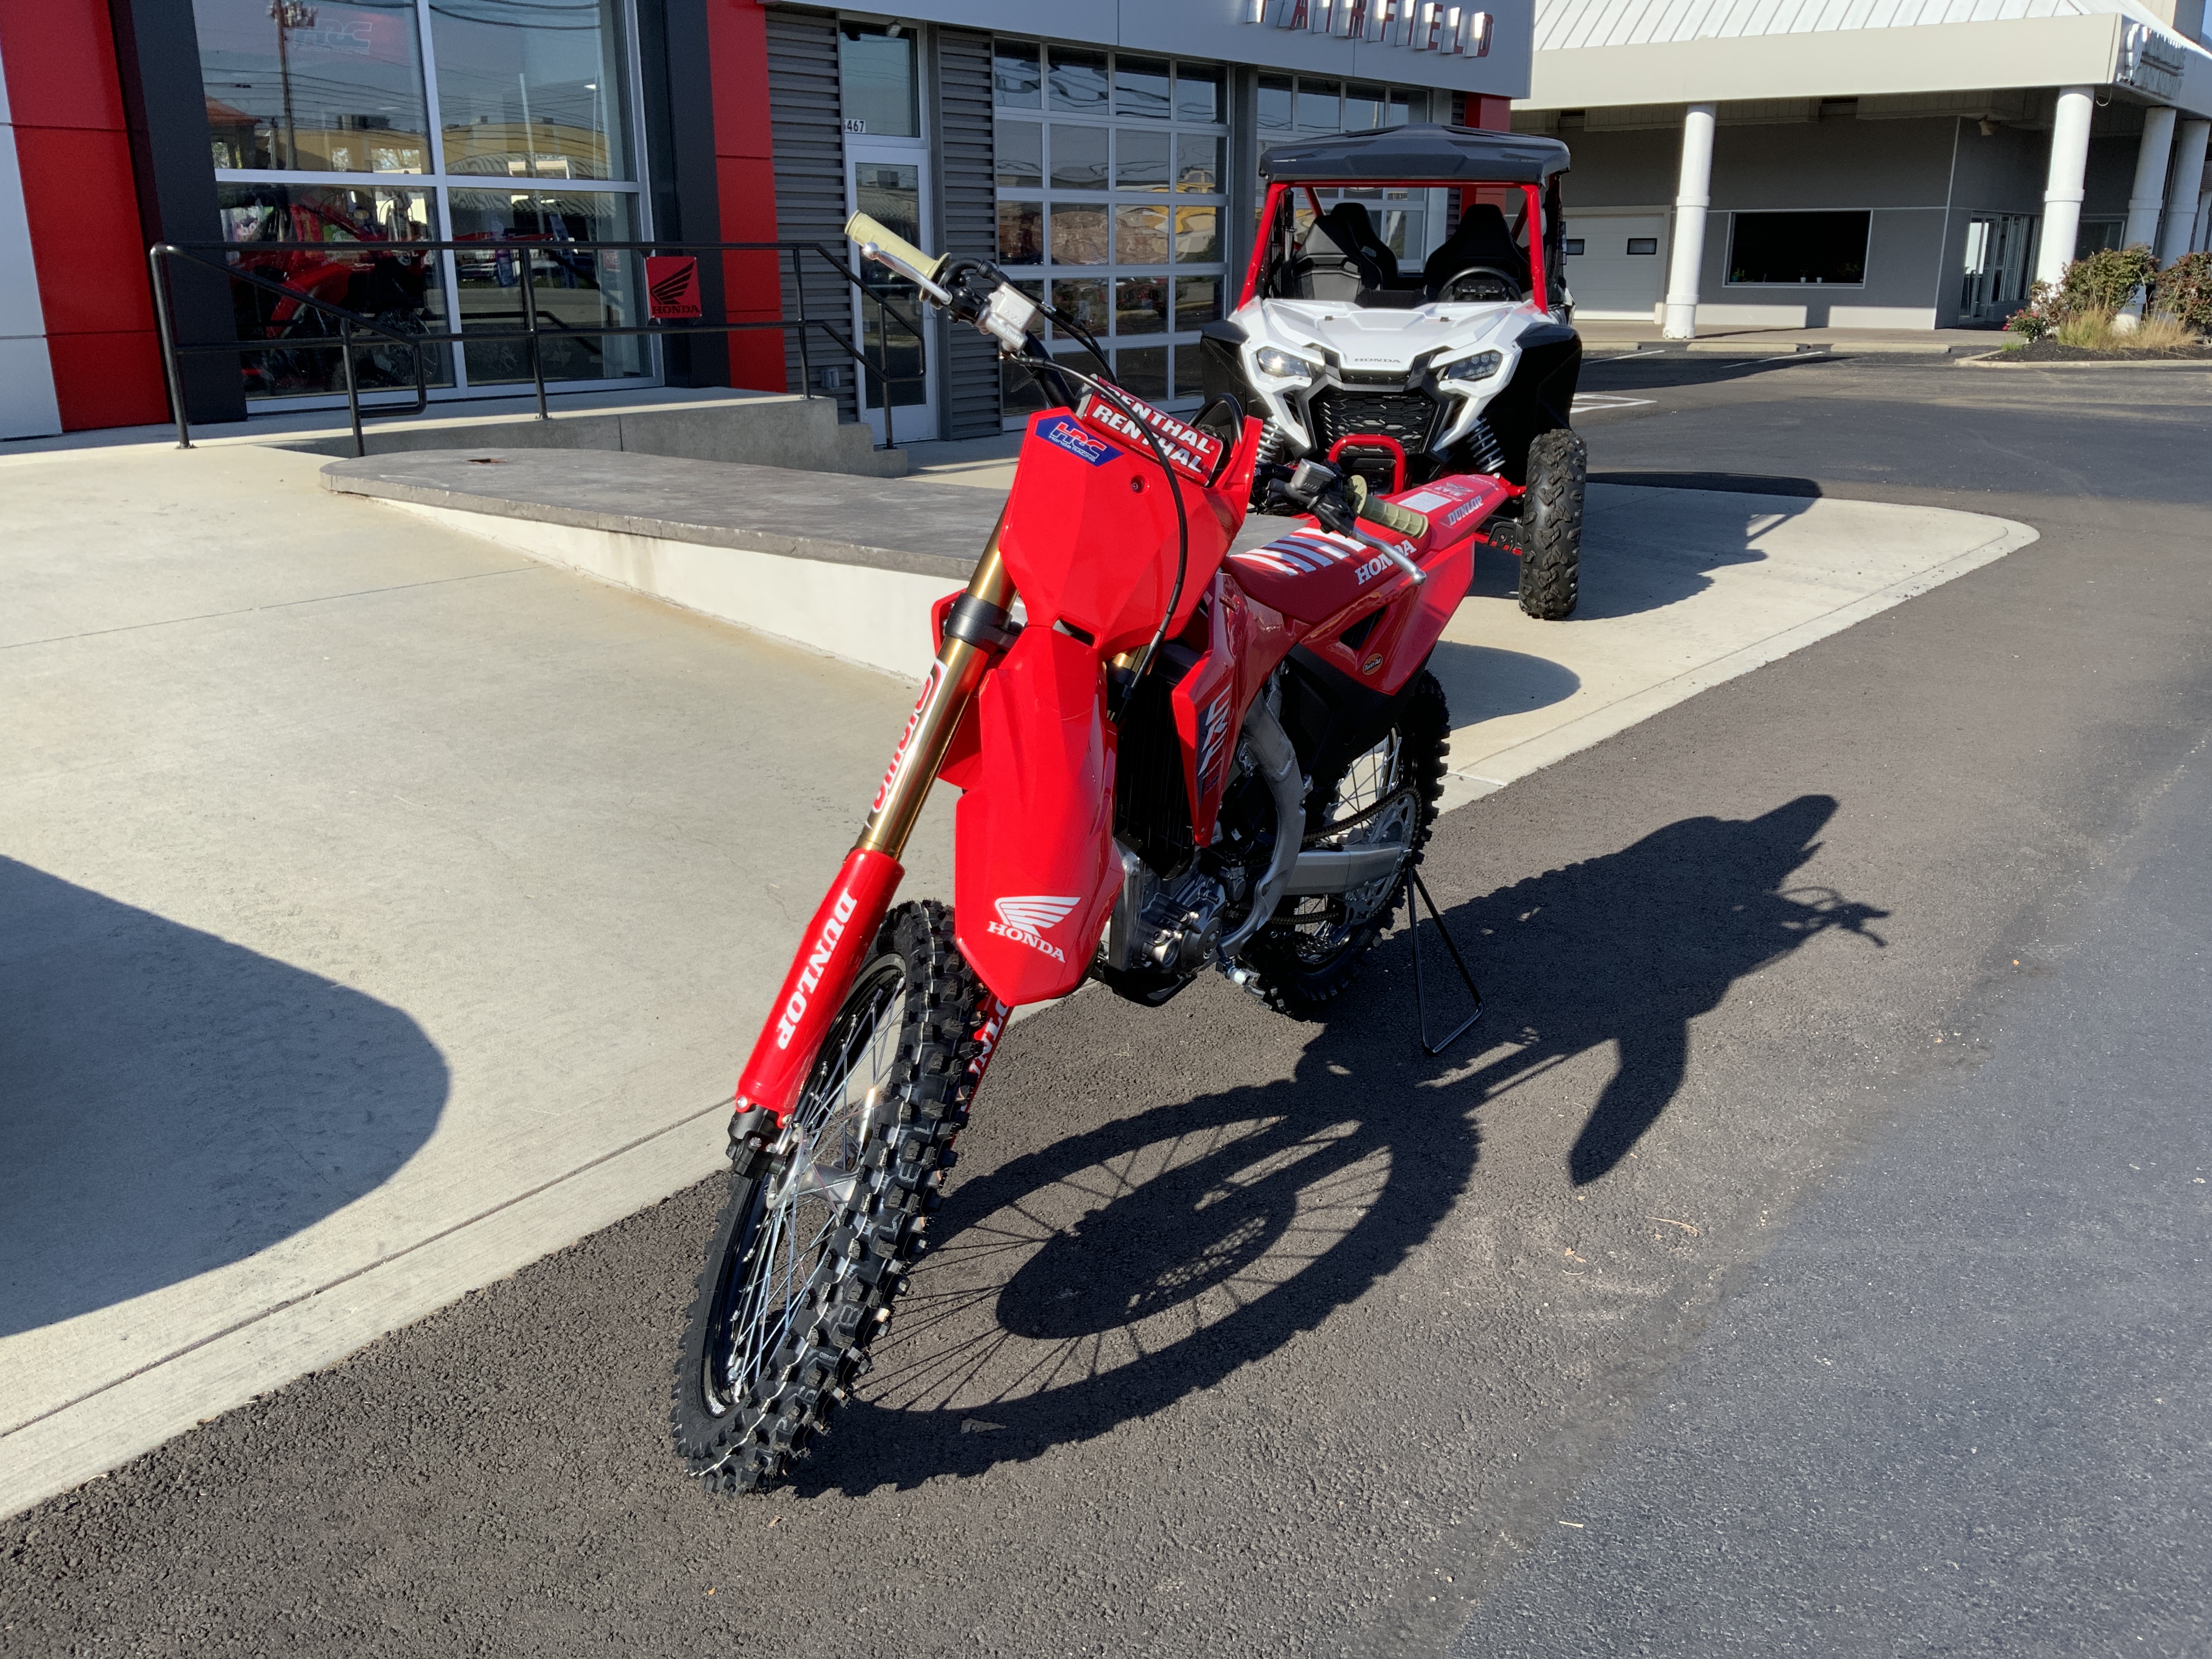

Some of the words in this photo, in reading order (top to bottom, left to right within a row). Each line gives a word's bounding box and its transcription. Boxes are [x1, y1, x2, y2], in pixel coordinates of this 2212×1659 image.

[844, 119, 865, 132] 467
[651, 304, 701, 314] HONDA
[1101, 386, 1211, 454] ENTHAL
[1048, 435, 1071, 449] Honda
[1072, 446, 1096, 462] RACING
[1050, 421, 1107, 459] HRC
[1447, 495, 1483, 526] DUNLOP
[987, 921, 1066, 963] HONDA
[777, 887, 858, 1051] DUNLOP
